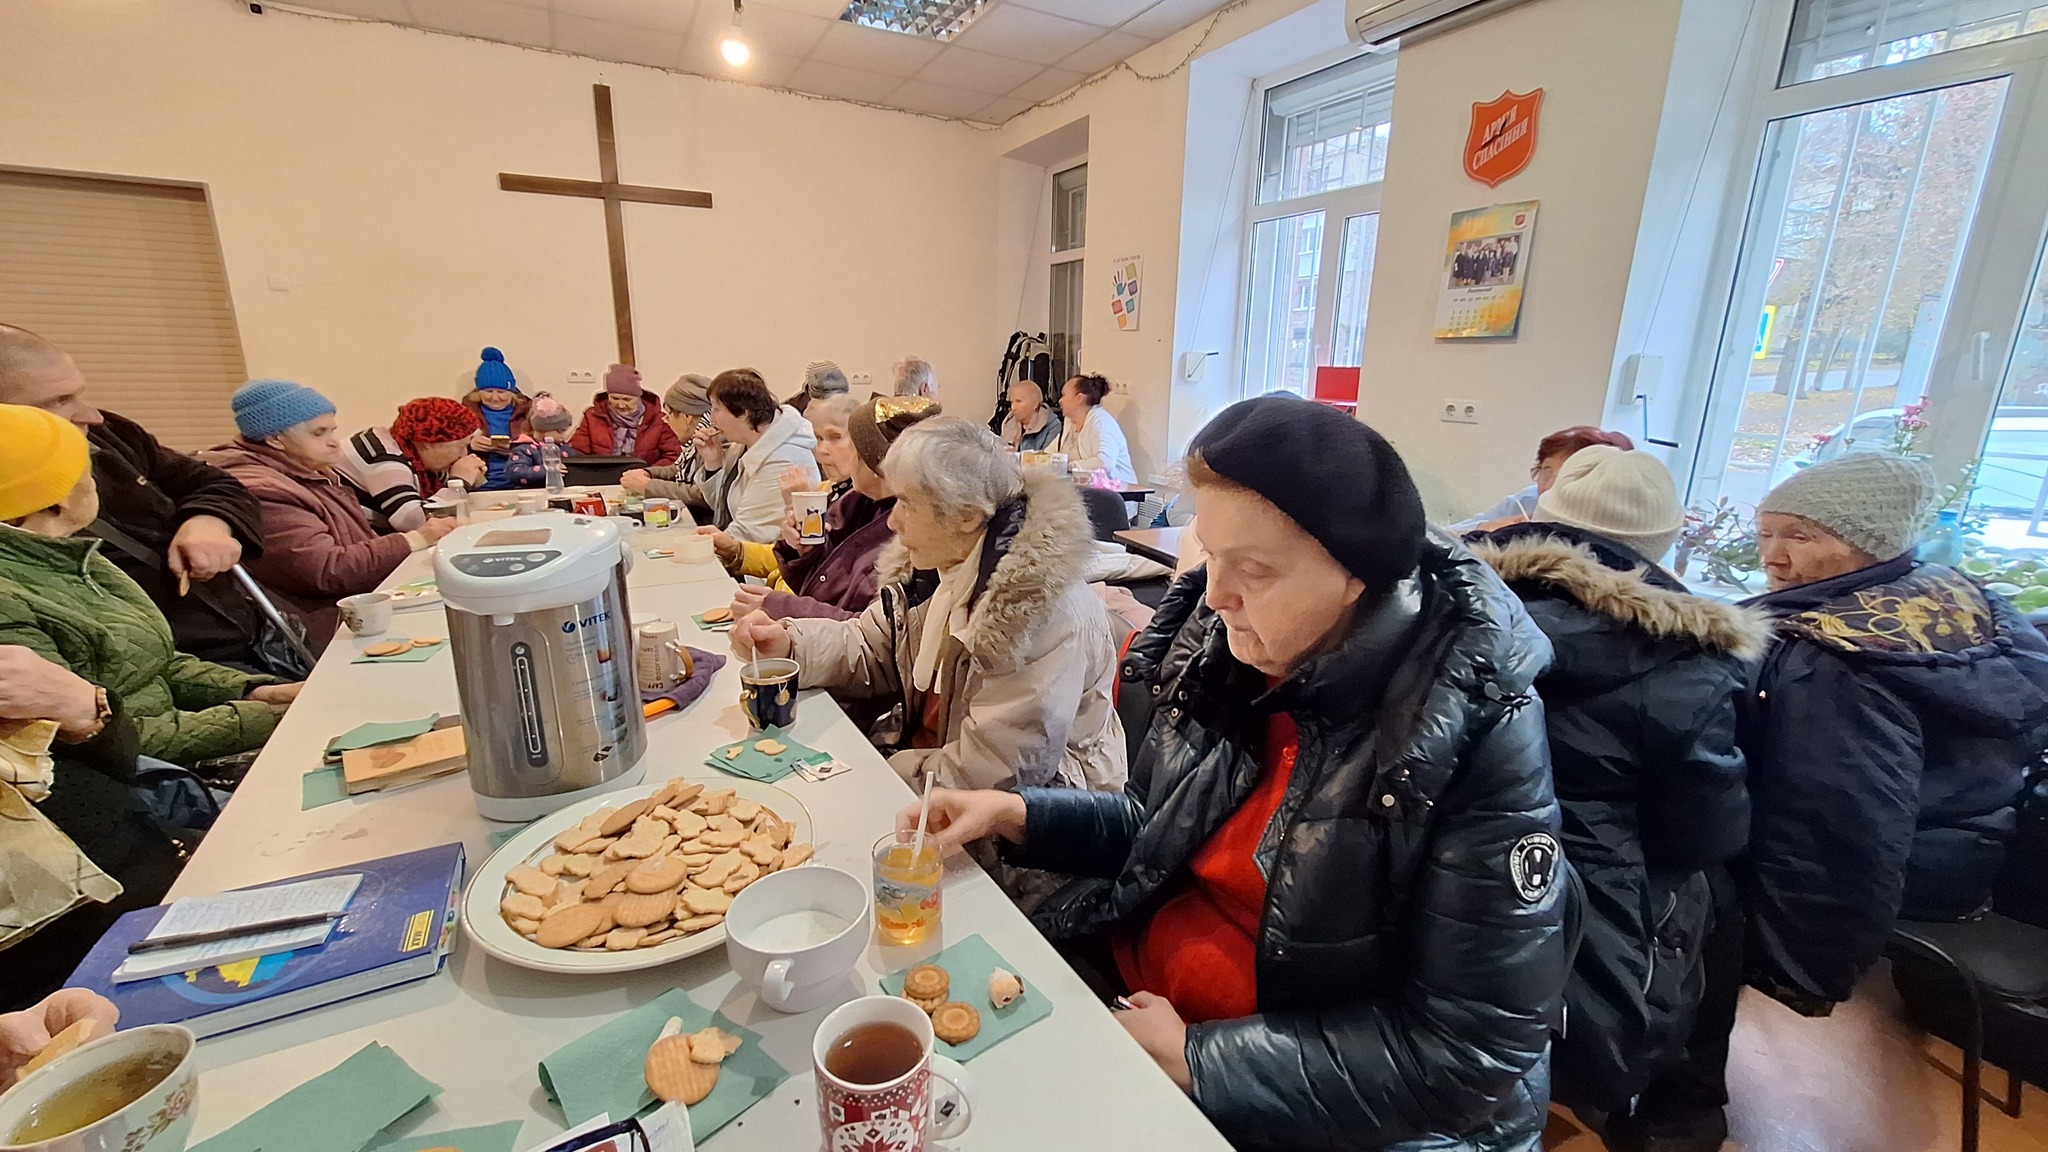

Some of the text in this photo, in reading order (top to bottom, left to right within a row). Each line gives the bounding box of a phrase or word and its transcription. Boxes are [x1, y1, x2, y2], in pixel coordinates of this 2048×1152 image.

[1473, 117, 1529, 170] СПАСІННЯ
[579, 611, 611, 628] VITEK
[654, 644, 662, 681] espresso
